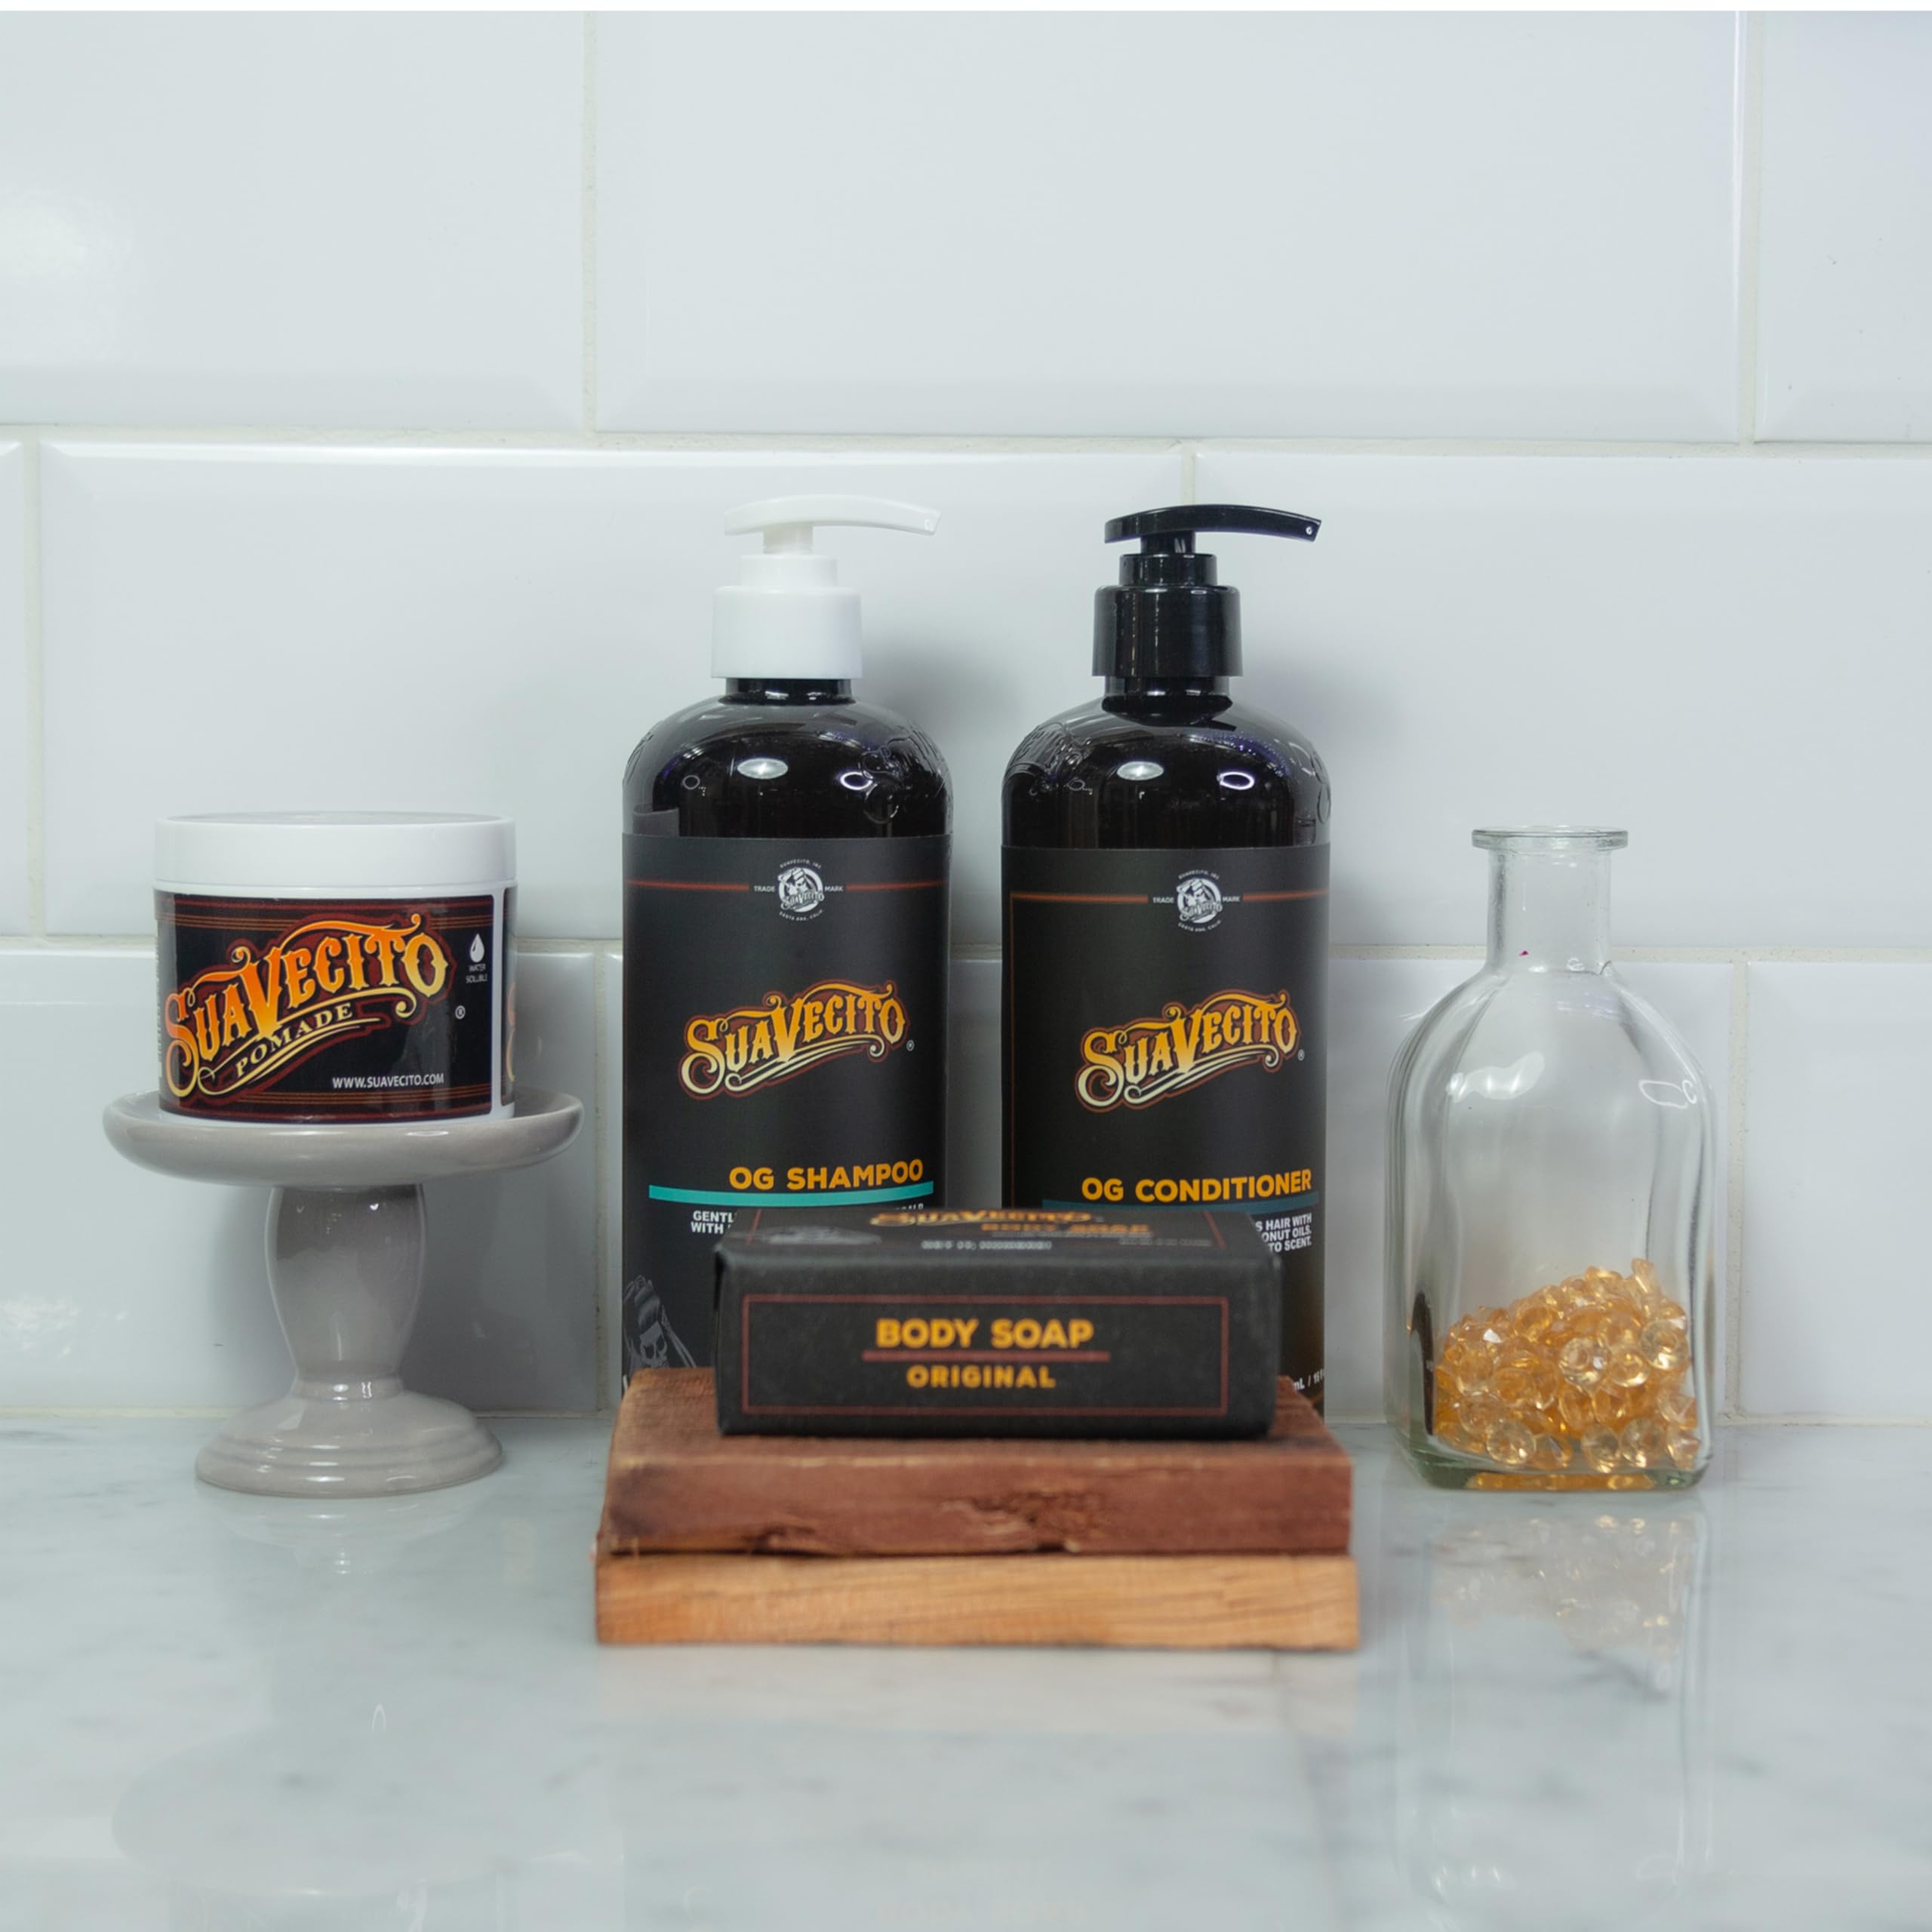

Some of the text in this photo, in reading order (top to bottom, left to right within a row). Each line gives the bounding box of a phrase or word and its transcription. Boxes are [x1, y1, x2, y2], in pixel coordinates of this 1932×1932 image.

[165, 913, 449, 1097] SUAVECITO
[235, 1003, 353, 1078] POMADE
[681, 983, 906, 1094] SUAVECITO
[1078, 992, 1299, 1106] SUAVECITO
[332, 1072, 444, 1088] WWW.SUAVECITO.COM
[729, 1158, 924, 1190] OG SHAMPOO
[1081, 1168, 1312, 1203] OG CONDITIONER
[691, 1221, 724, 1234] WITH
[693, 1211, 737, 1223] GENTL
[1266, 1217, 1291, 1230] HAIR
[1291, 1212, 1312, 1226] WITH
[1261, 1229, 1291, 1243] ONUT
[875, 1318, 1094, 1349] BODY SOAP
[906, 1364, 1056, 1389] ORIGINAL
